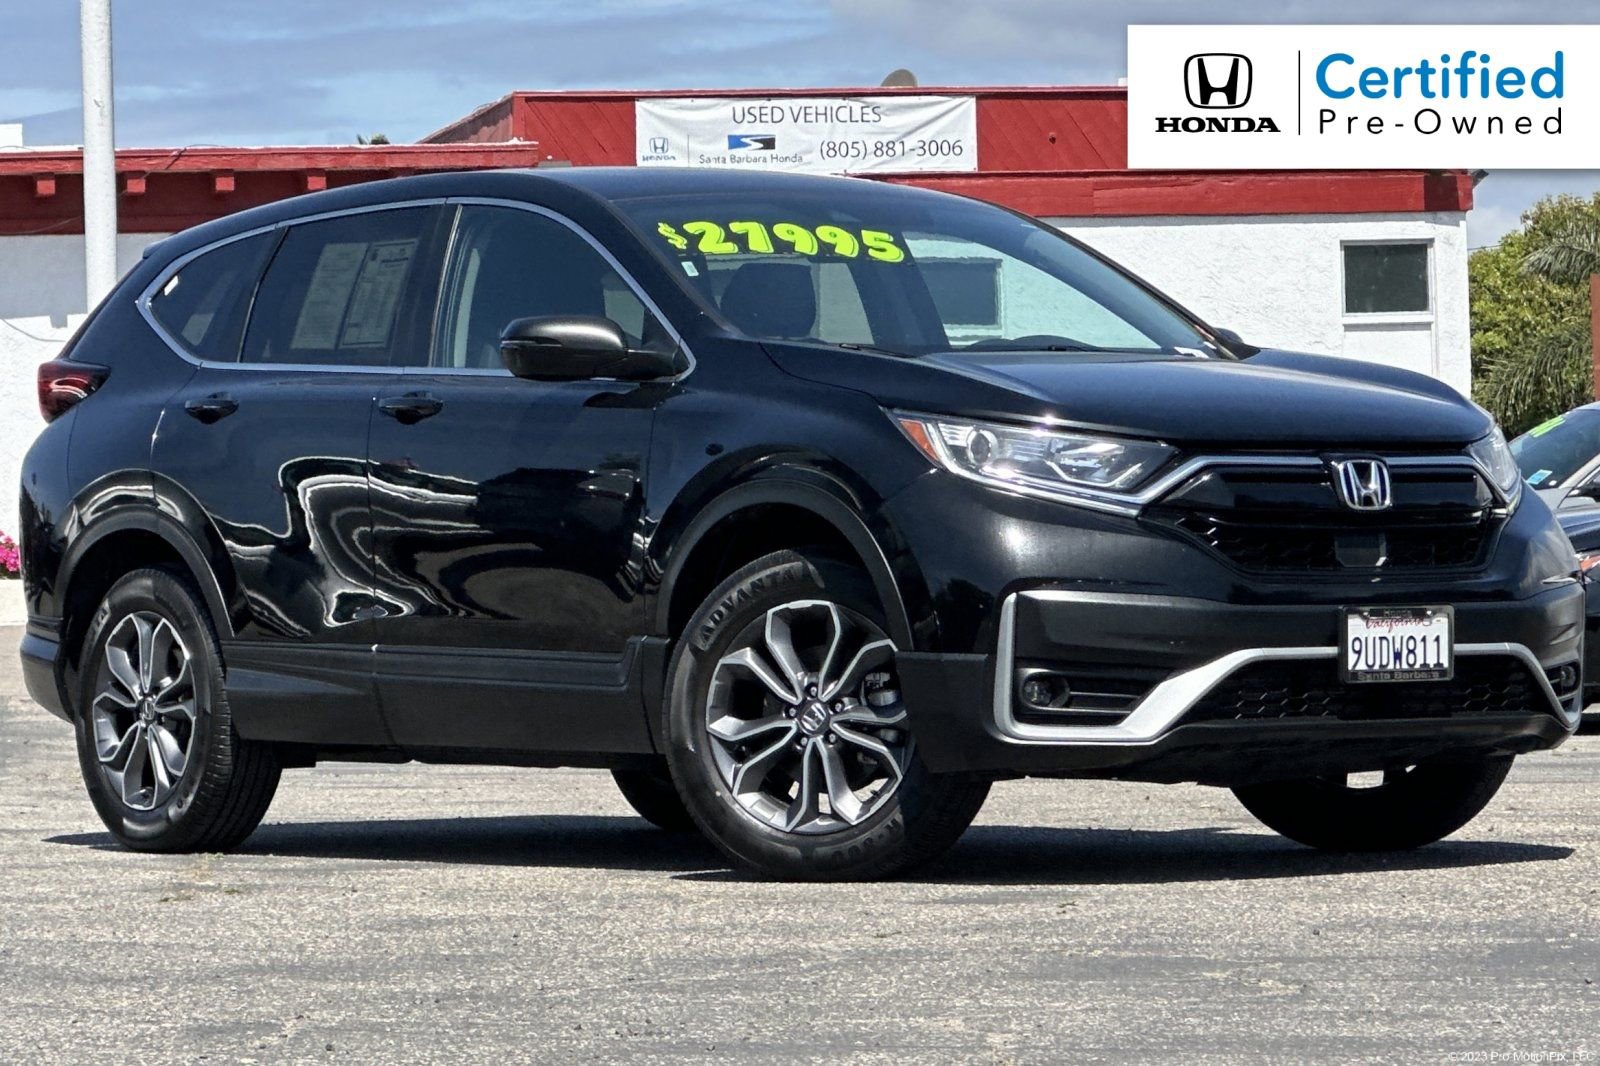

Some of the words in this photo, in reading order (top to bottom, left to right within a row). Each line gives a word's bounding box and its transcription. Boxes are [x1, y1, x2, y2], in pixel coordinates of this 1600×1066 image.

[732, 106, 784, 124] USED
[790, 105, 882, 124] VEHICLES
[700, 154, 727, 164] Santa
[730, 153, 767, 164] Barbara
[771, 153, 803, 164] Honda
[820, 140, 868, 159] (805)
[874, 139, 963, 158] 881-3006
[658, 221, 904, 262] $27995
[1351, 634, 1444, 671] 9UDW811
